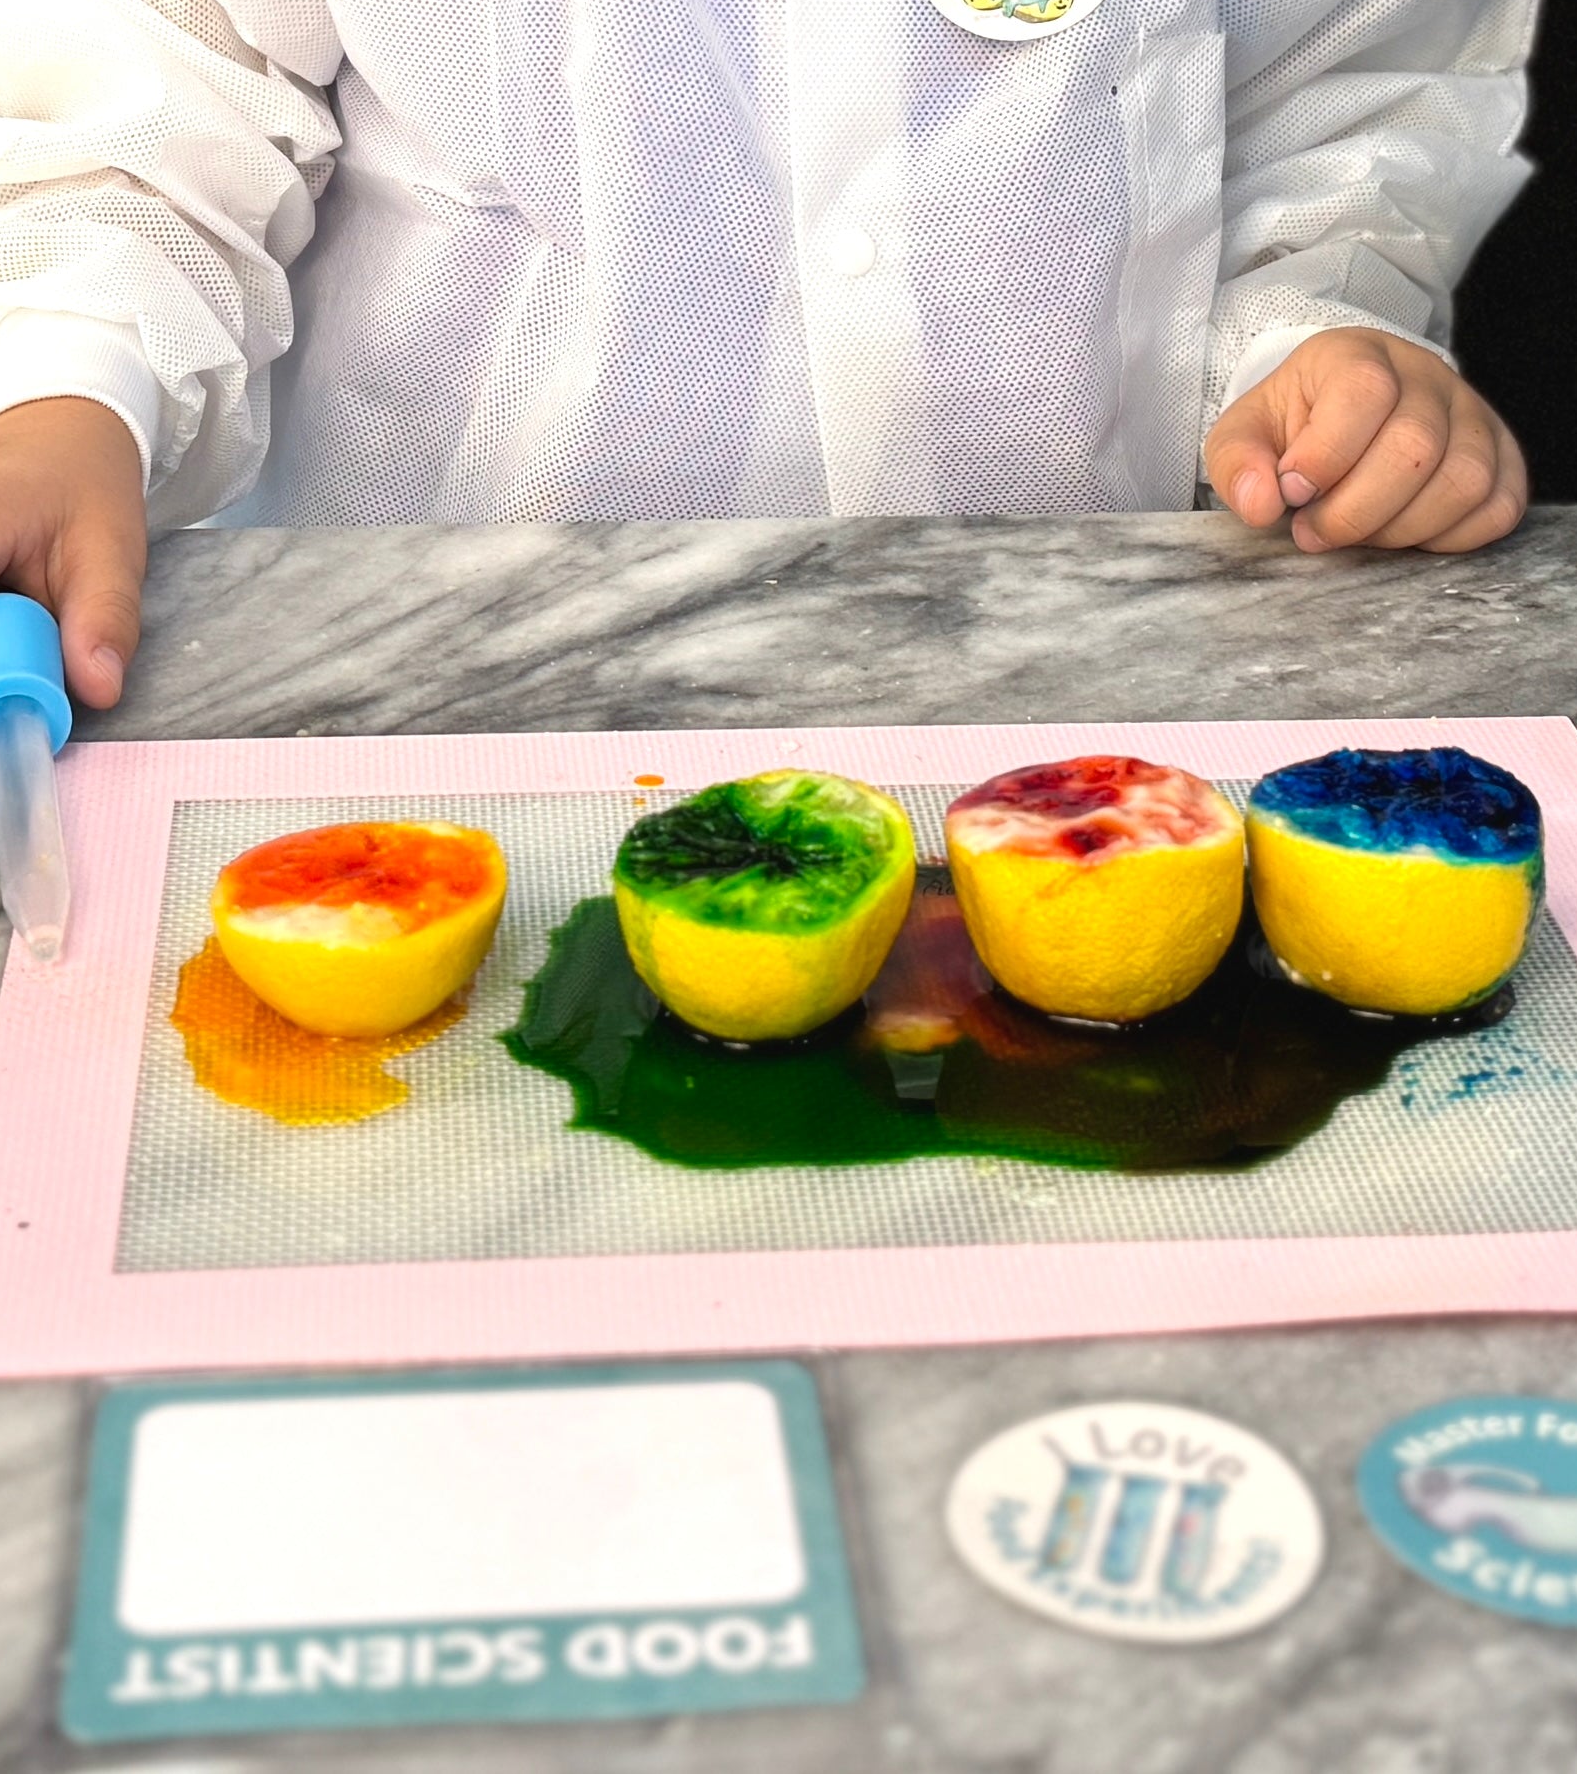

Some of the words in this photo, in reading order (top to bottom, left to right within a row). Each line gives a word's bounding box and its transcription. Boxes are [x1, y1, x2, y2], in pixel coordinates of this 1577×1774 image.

[1088, 1421, 1249, 1484] Love
[110, 1624, 547, 1704] SCIENTIST
[564, 1613, 814, 1679] FOOD
